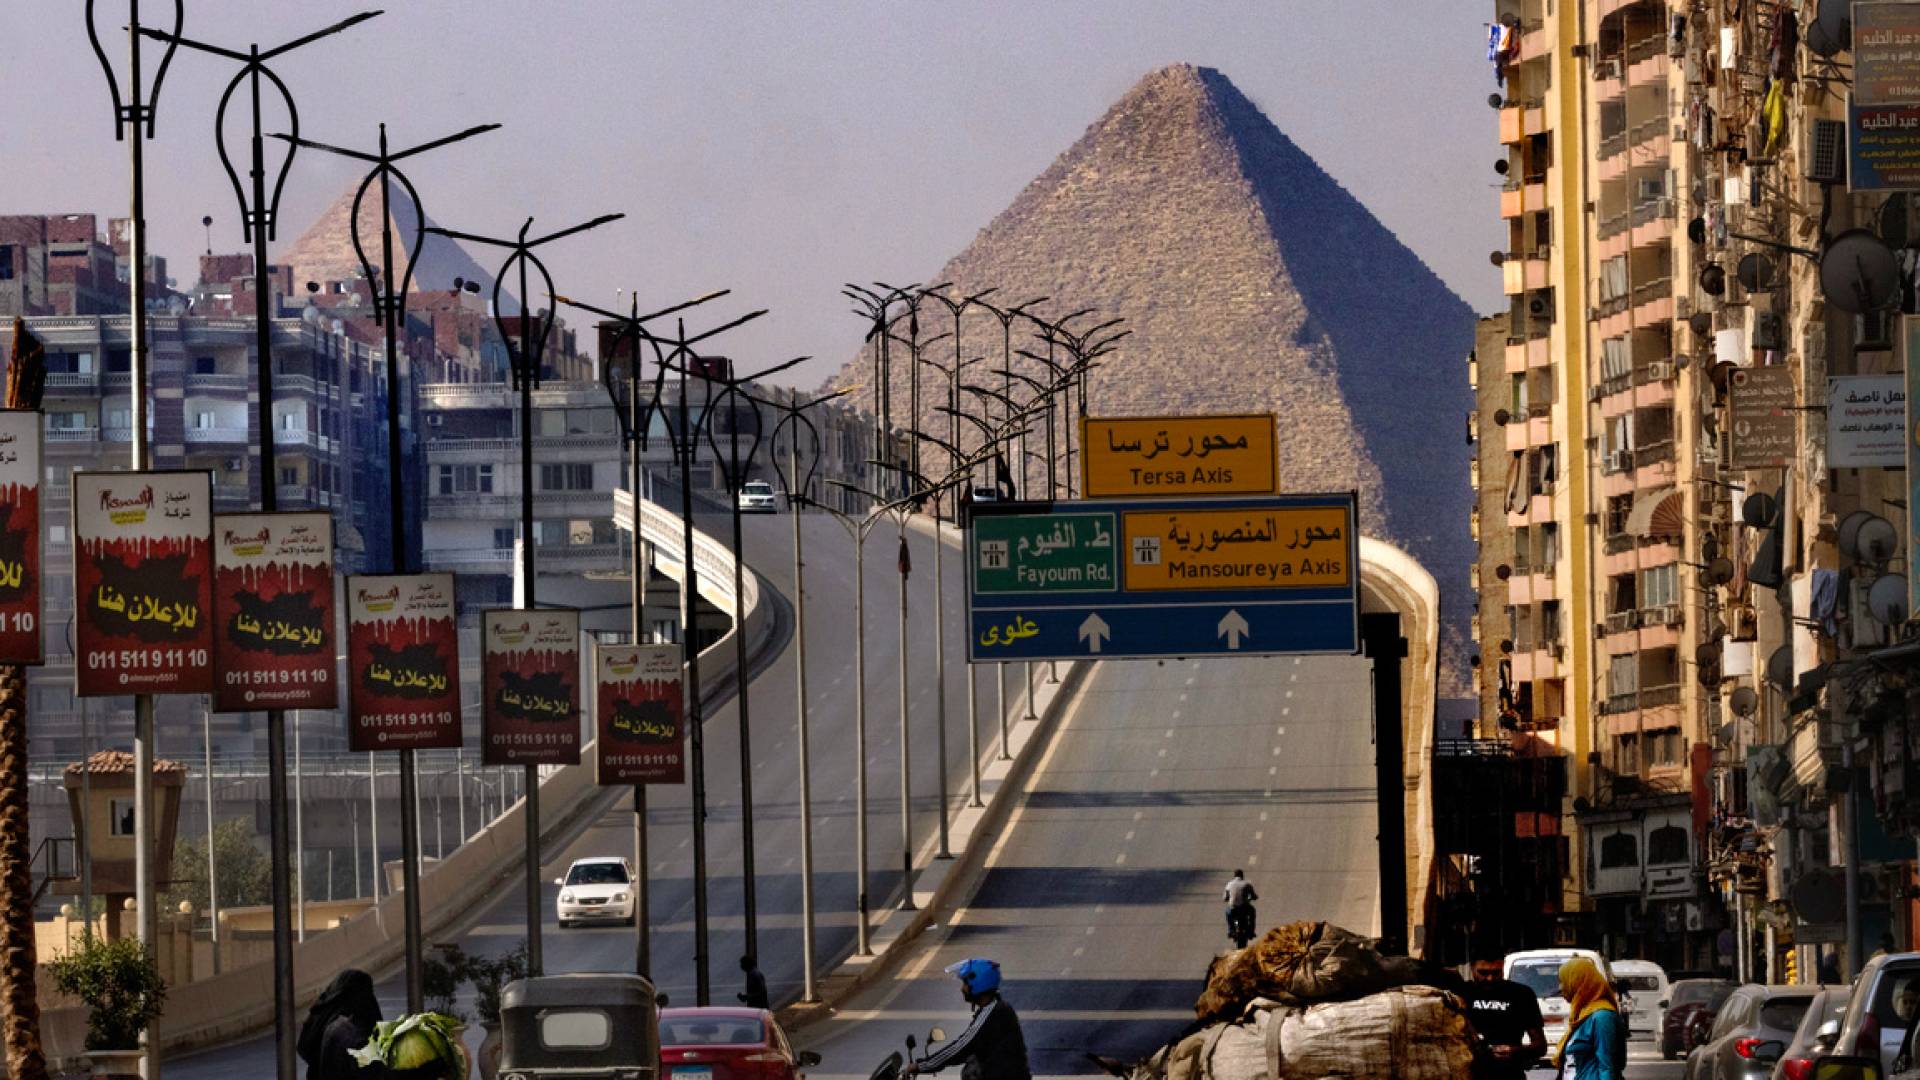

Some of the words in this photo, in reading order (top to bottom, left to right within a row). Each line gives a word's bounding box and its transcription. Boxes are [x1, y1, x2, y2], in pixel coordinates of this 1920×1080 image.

[1108, 429, 1169, 459] ترسا
[1176, 433, 1248, 458] محور
[1130, 467, 1186, 486] Tersa
[1192, 466, 1233, 484] Axis
[163, 507, 191, 520] شركة
[1017, 521, 1076, 561] الفيوم
[1168, 516, 1277, 552] المنصورية
[1286, 524, 1341, 549] محور
[1017, 565, 1082, 587] Fayoum
[1086, 563, 1111, 581] Rd.
[1168, 561, 1293, 581] Mansoureya
[1300, 558, 1341, 576] Axis
[97, 585, 126, 613] هنا
[12, 612, 34, 632] 10
[89, 651, 116, 669] 011
[121, 650, 148, 668] 511
[152, 650, 162, 668] 9
[166, 649, 184, 667] 11
[187, 649, 208, 667] 10
[226, 671, 249, 684] 011
[253, 670, 277, 684] 511
[280, 670, 289, 683] 9
[292, 669, 307, 683] 11
[311, 668, 328, 682] 10
[360, 714, 382, 727] 011
[385, 713, 407, 726] 511
[409, 713, 417, 725] 9
[420, 712, 434, 724] 11
[437, 711, 452, 724] 10
